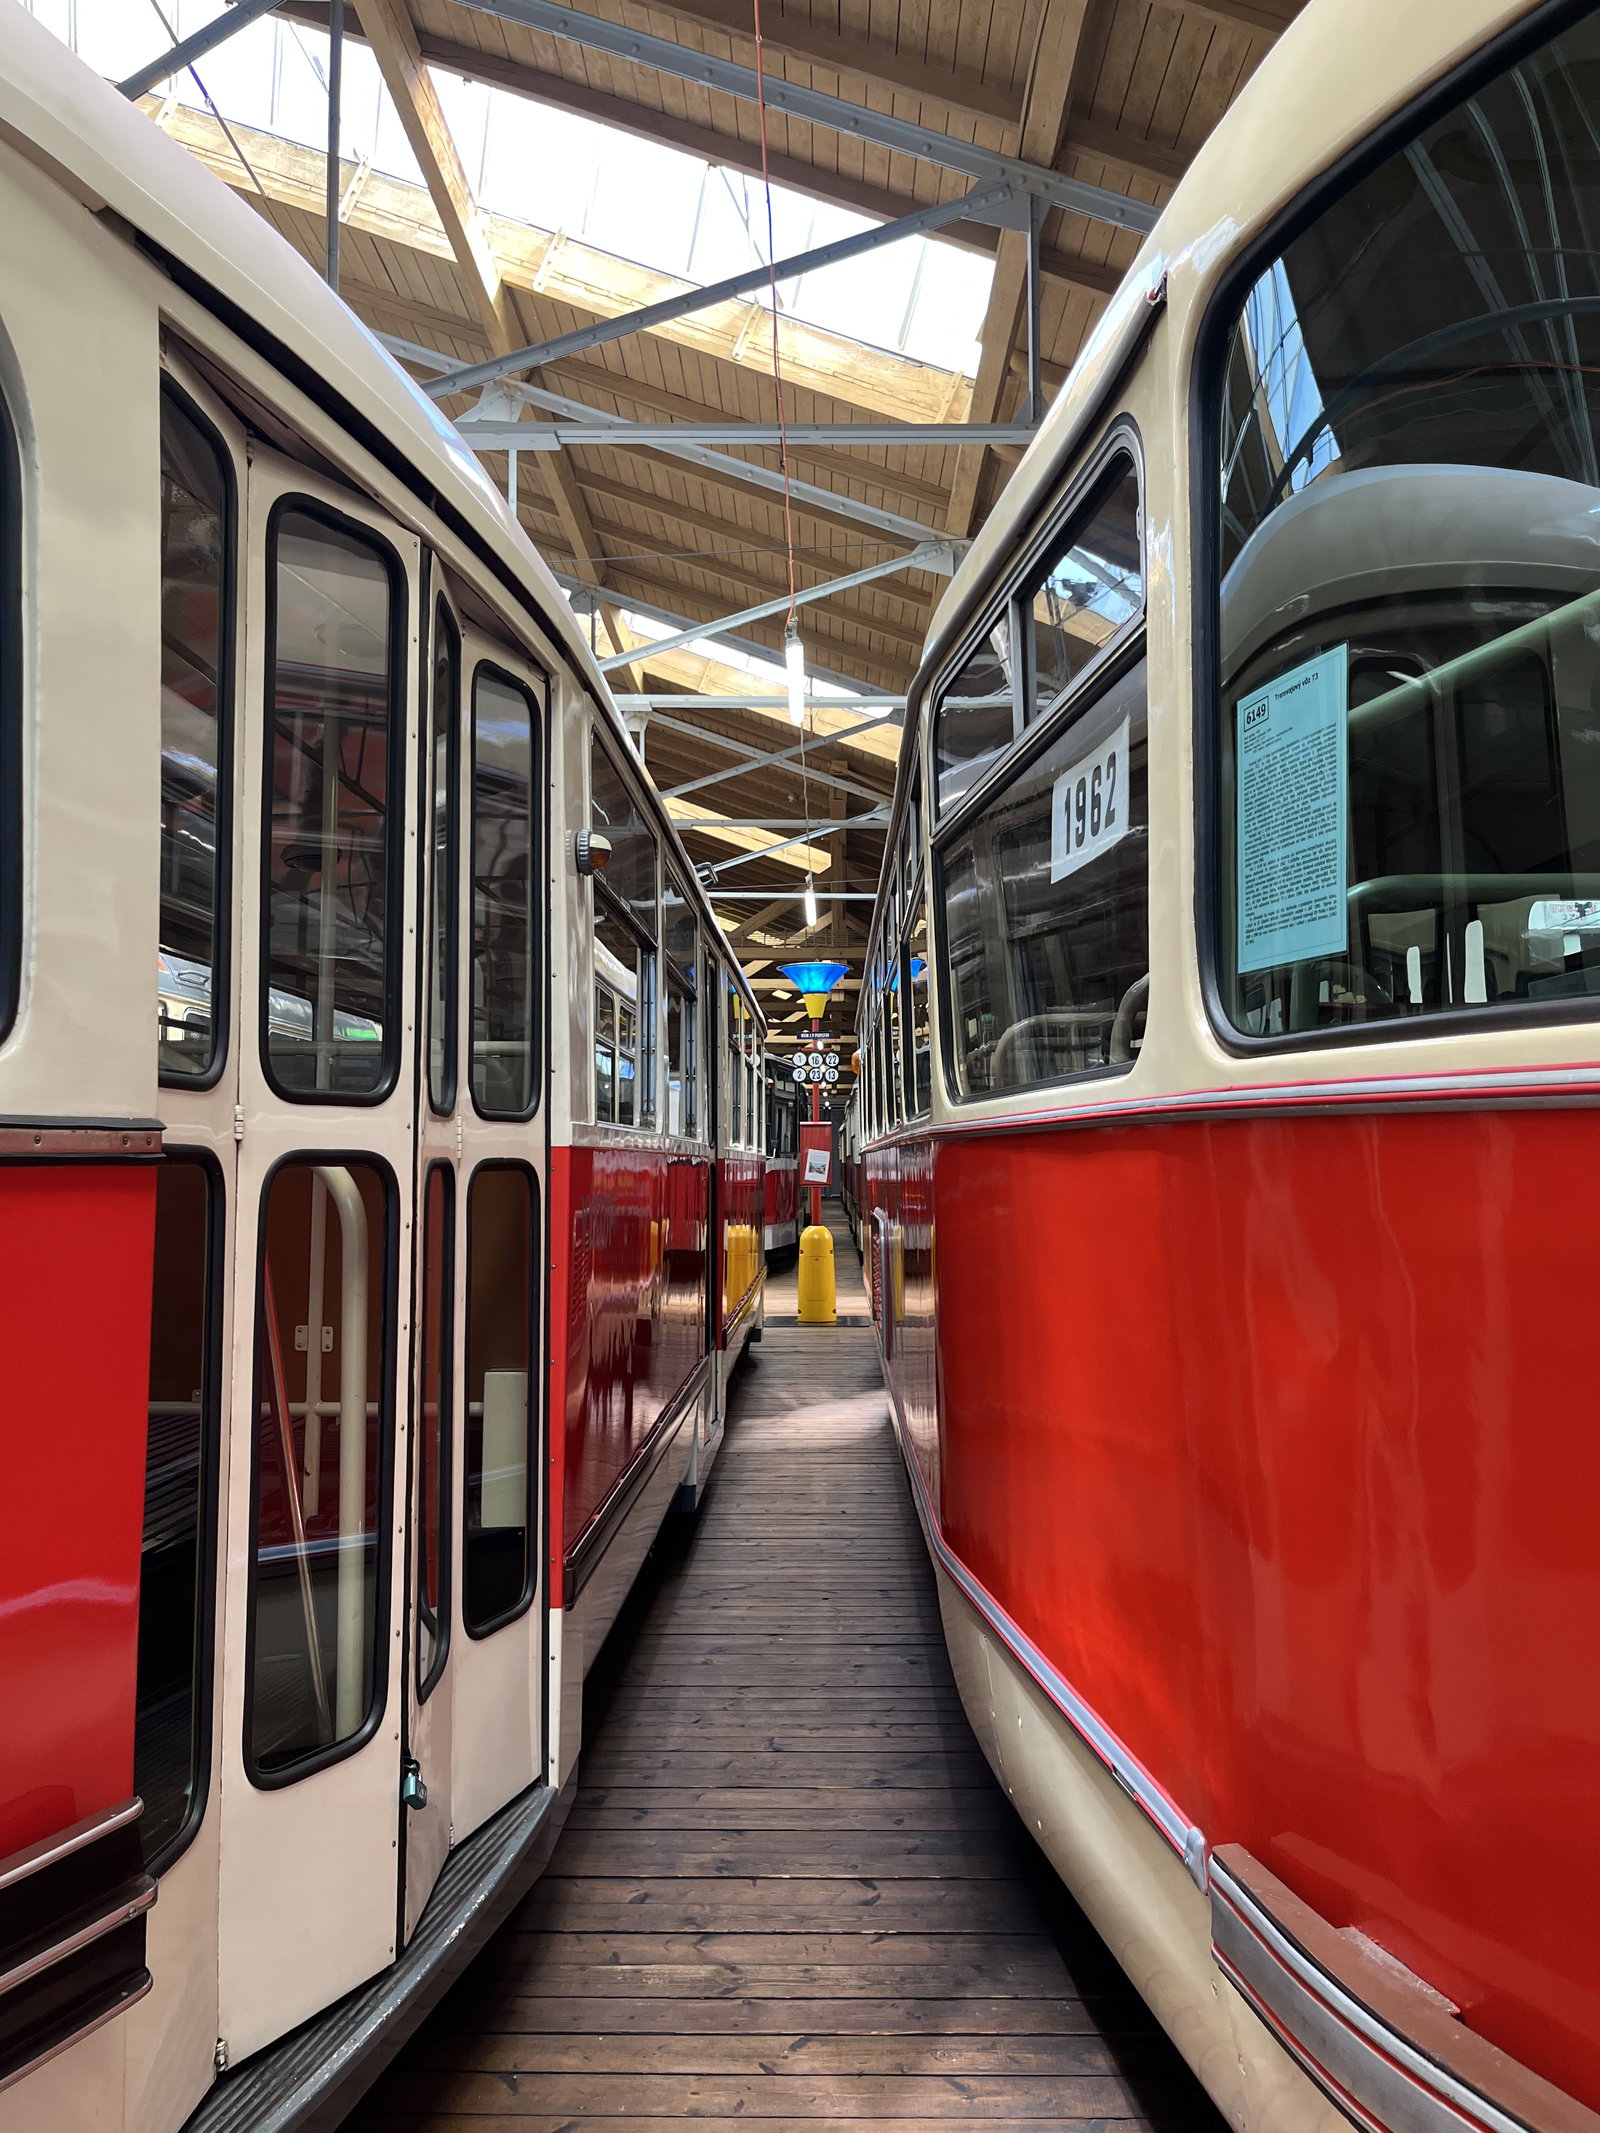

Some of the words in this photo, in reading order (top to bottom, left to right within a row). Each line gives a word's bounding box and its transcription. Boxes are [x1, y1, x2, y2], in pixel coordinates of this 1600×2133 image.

[1274, 680, 1302, 701] Tramvajový
[1311, 672, 1319, 683] T3
[1246, 703, 1267, 725] 6149
[1064, 751, 1116, 856] 1962
[811, 1055, 820, 1065] 16
[827, 1055, 837, 1065] 22
[811, 1070, 820, 1080] 23
[828, 1070, 836, 1080] 13
